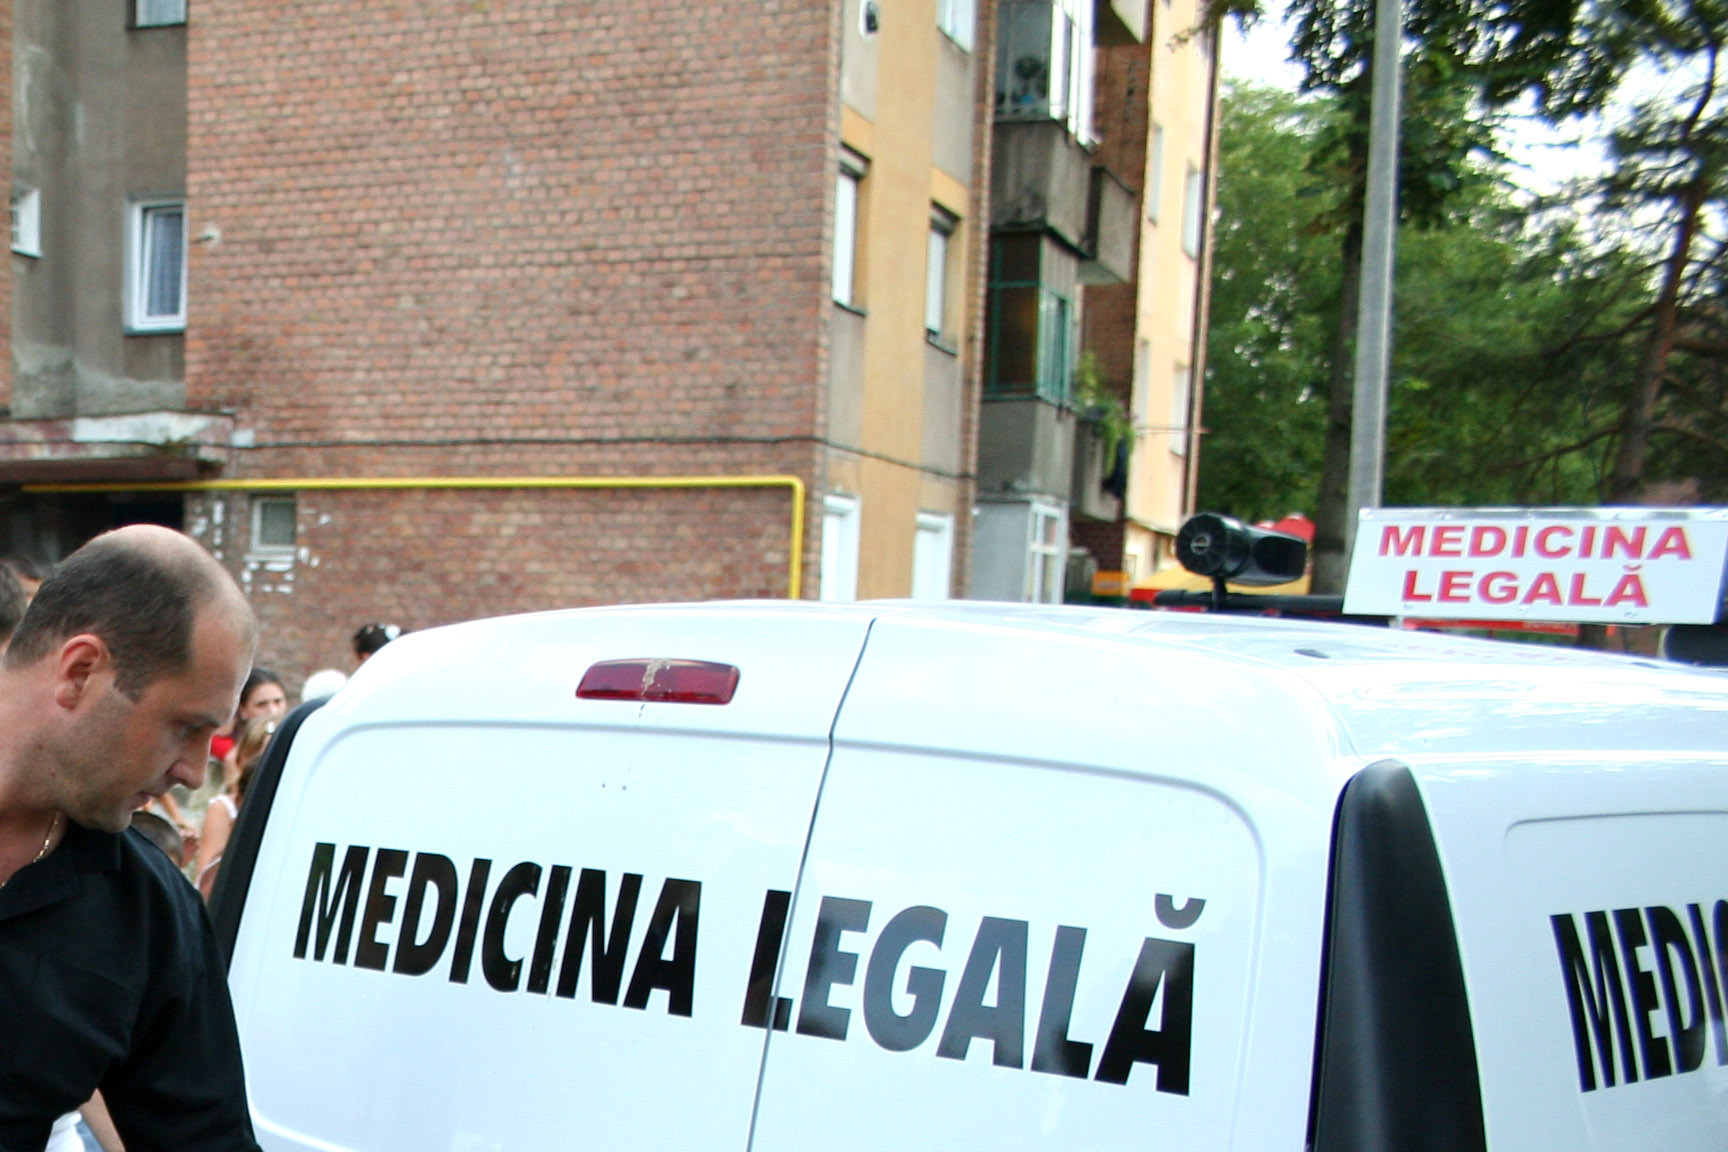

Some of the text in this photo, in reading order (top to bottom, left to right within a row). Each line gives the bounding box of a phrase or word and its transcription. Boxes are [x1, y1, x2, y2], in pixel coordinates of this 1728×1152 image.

[1377, 525, 1693, 560] MEDICINA
[1400, 564, 1649, 607] LEGALĂ
[293, 842, 1207, 1097] MEDICINA LEGALĂ
